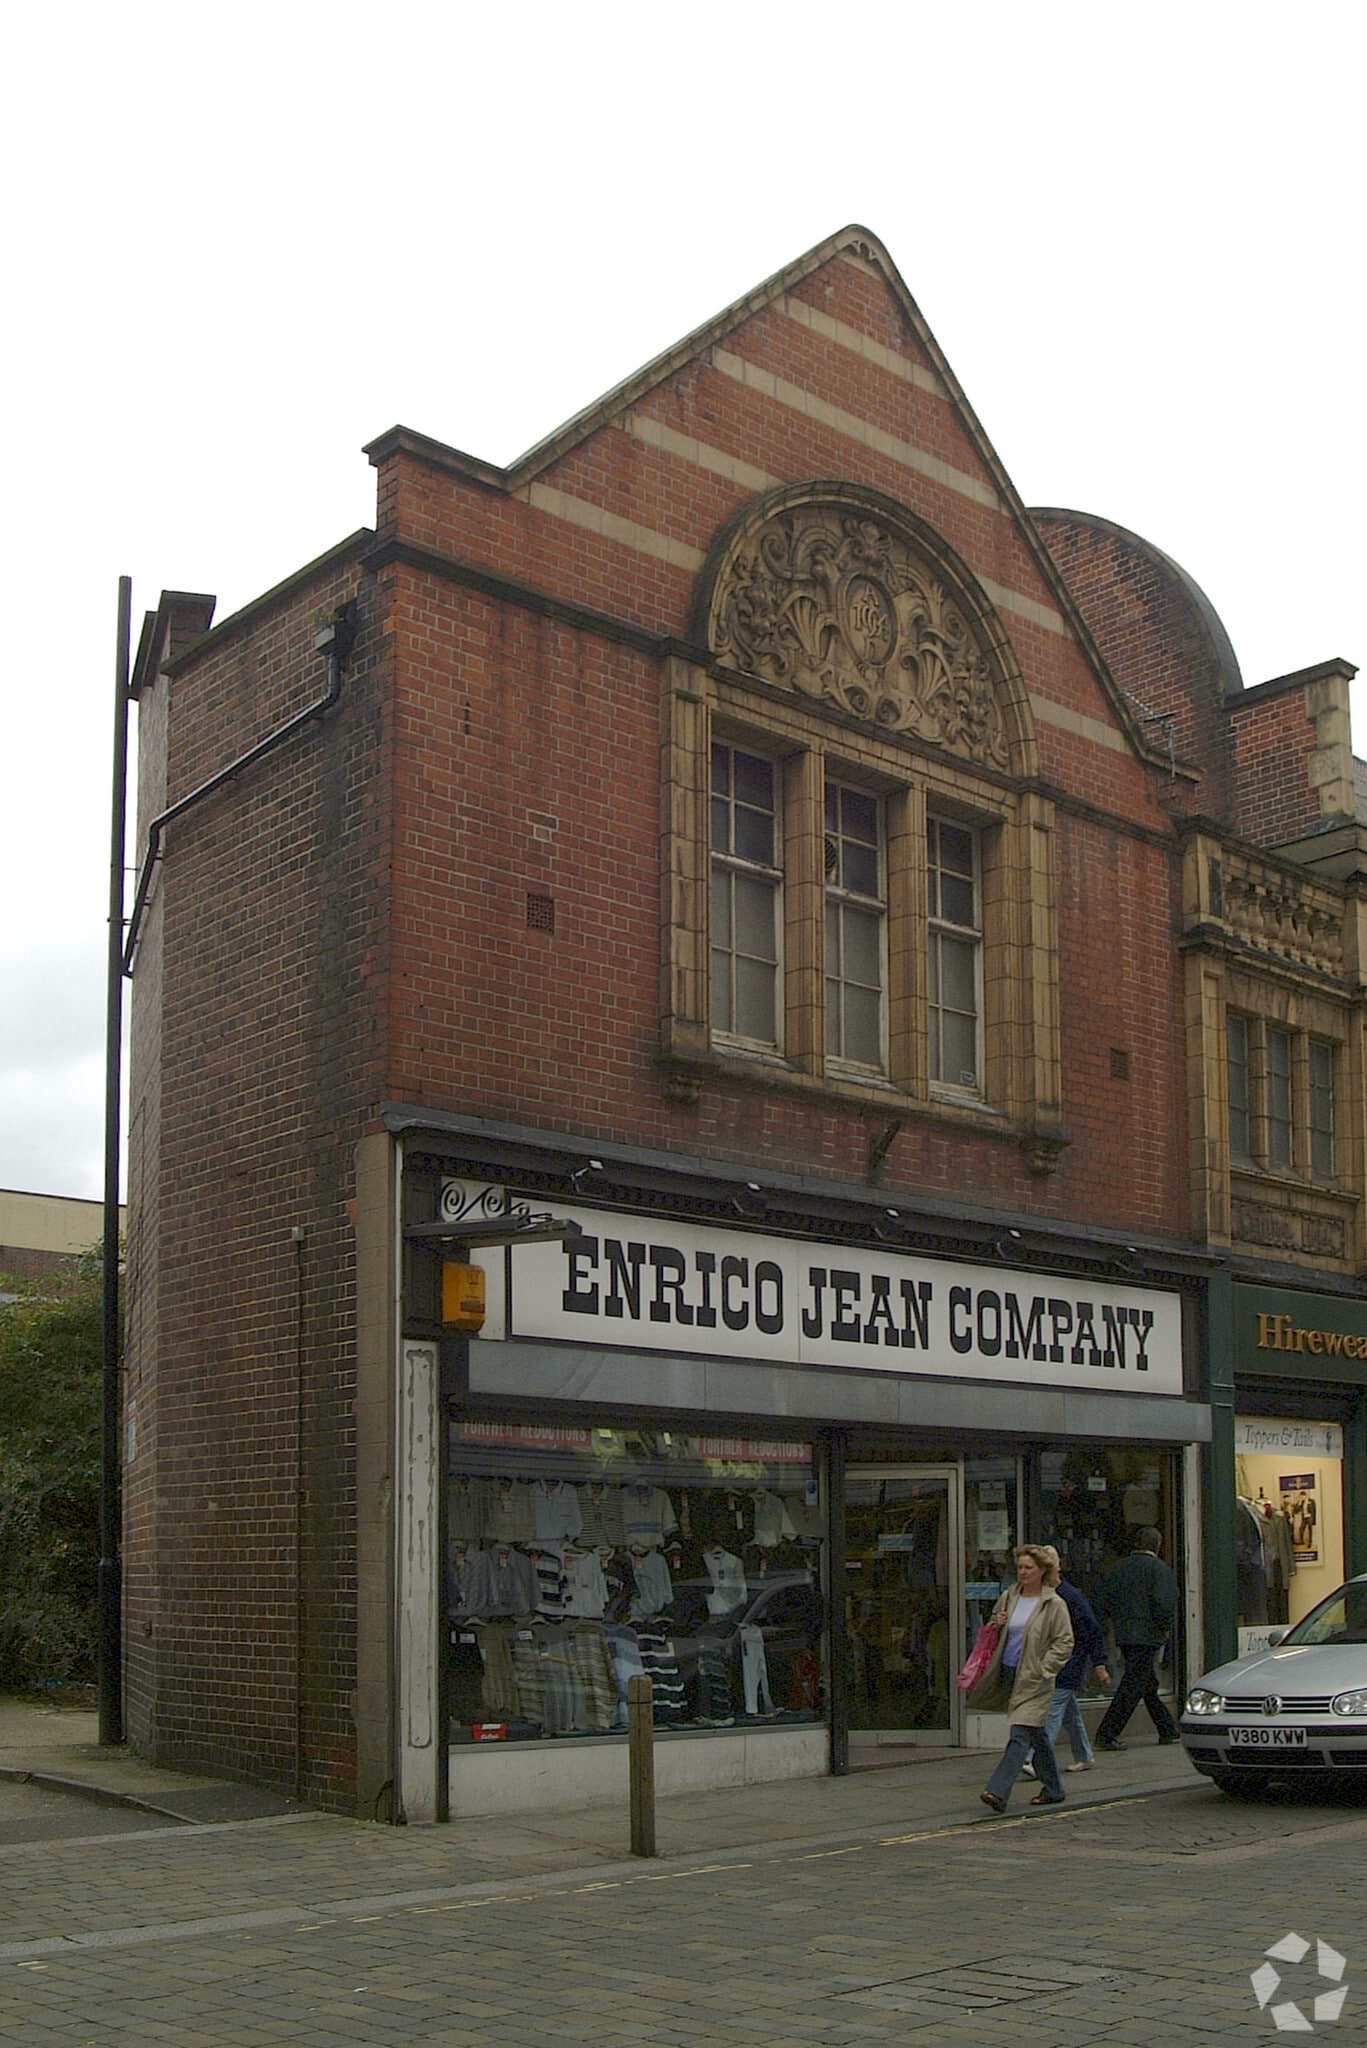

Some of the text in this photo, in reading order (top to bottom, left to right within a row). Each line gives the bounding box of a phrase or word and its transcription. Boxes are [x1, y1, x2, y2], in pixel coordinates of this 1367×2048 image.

[562, 1234, 1154, 1372] ENRICO JEAN COMPANY
[1231, 1729, 1305, 1745] V380 KWW
